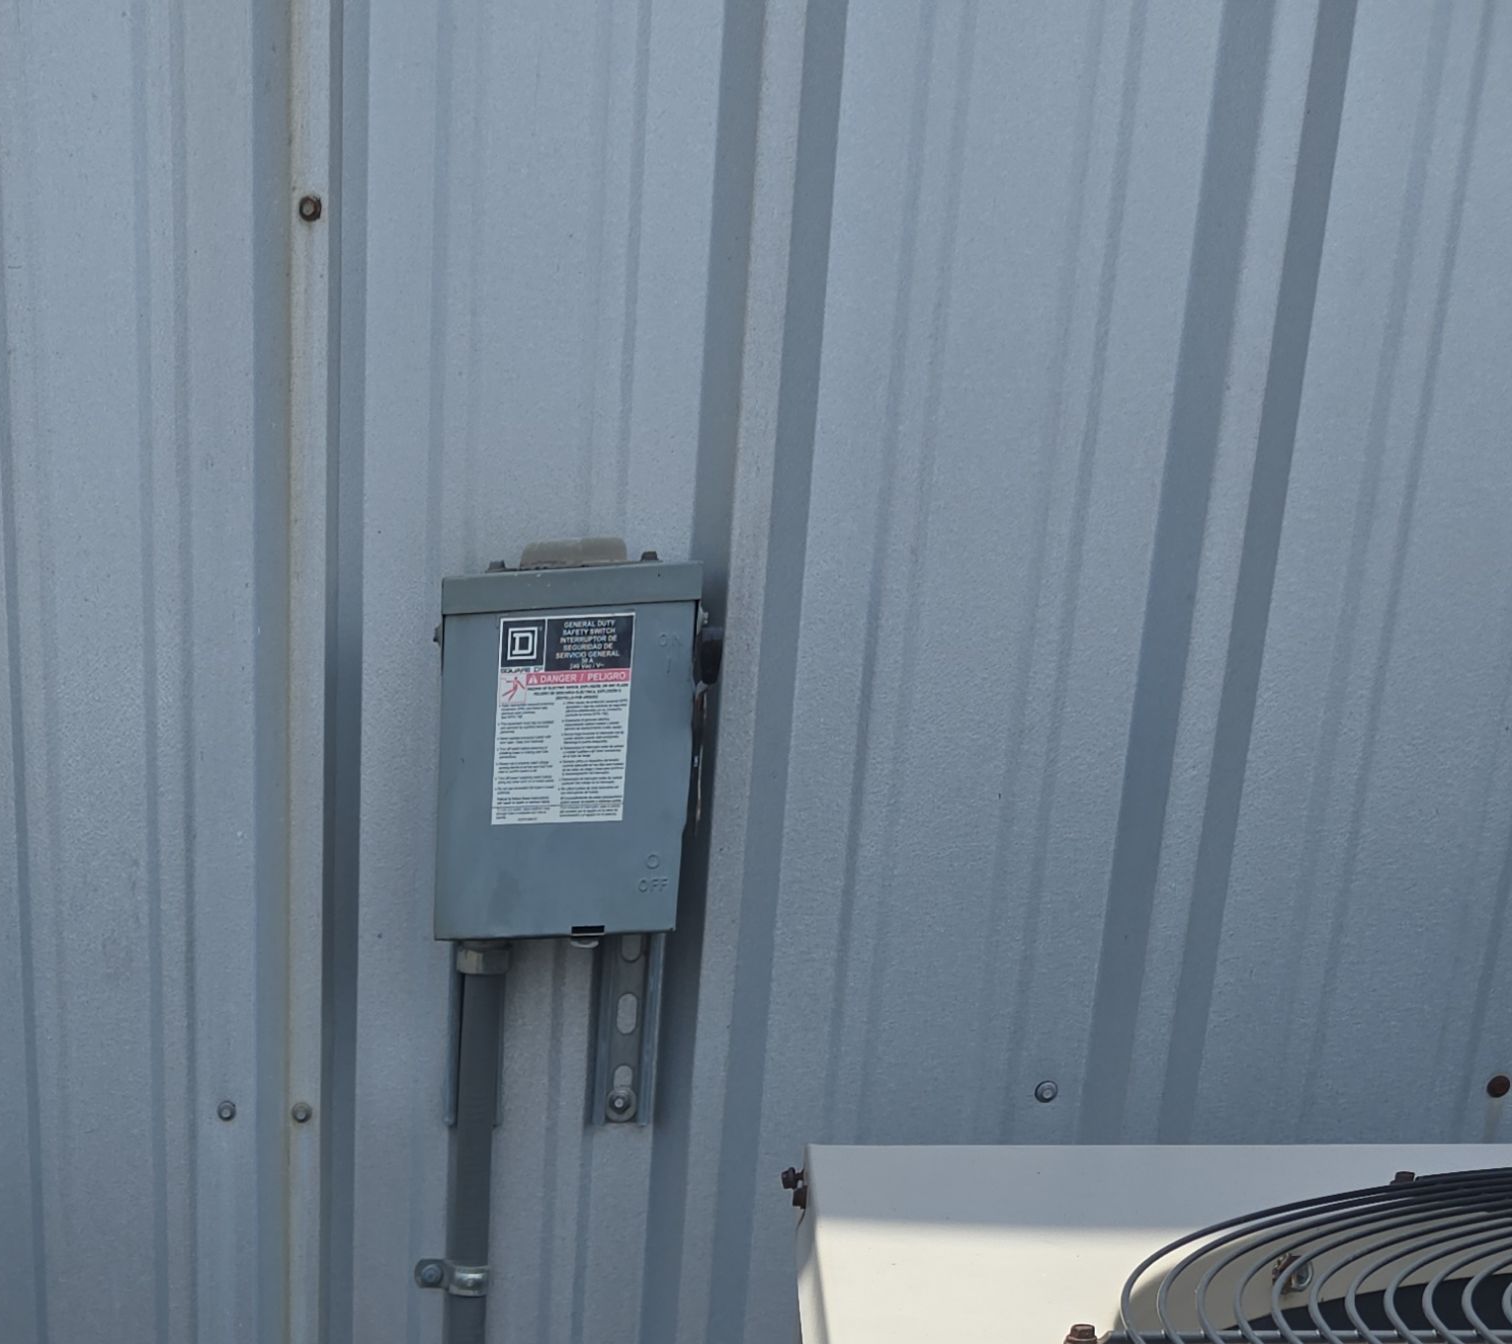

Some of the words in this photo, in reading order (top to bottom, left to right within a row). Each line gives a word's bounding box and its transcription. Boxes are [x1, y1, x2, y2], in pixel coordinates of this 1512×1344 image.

[564, 620, 596, 628] GENERAL
[597, 619, 616, 627] DUTY
[560, 636, 607, 644] INTERRUPTOR
[608, 634, 617, 642] DE
[588, 650, 620, 658] GENERAL
[540, 674, 577, 683] DANGER
[587, 672, 626, 681] PELIGRO
[638, 878, 668, 893] OFF
